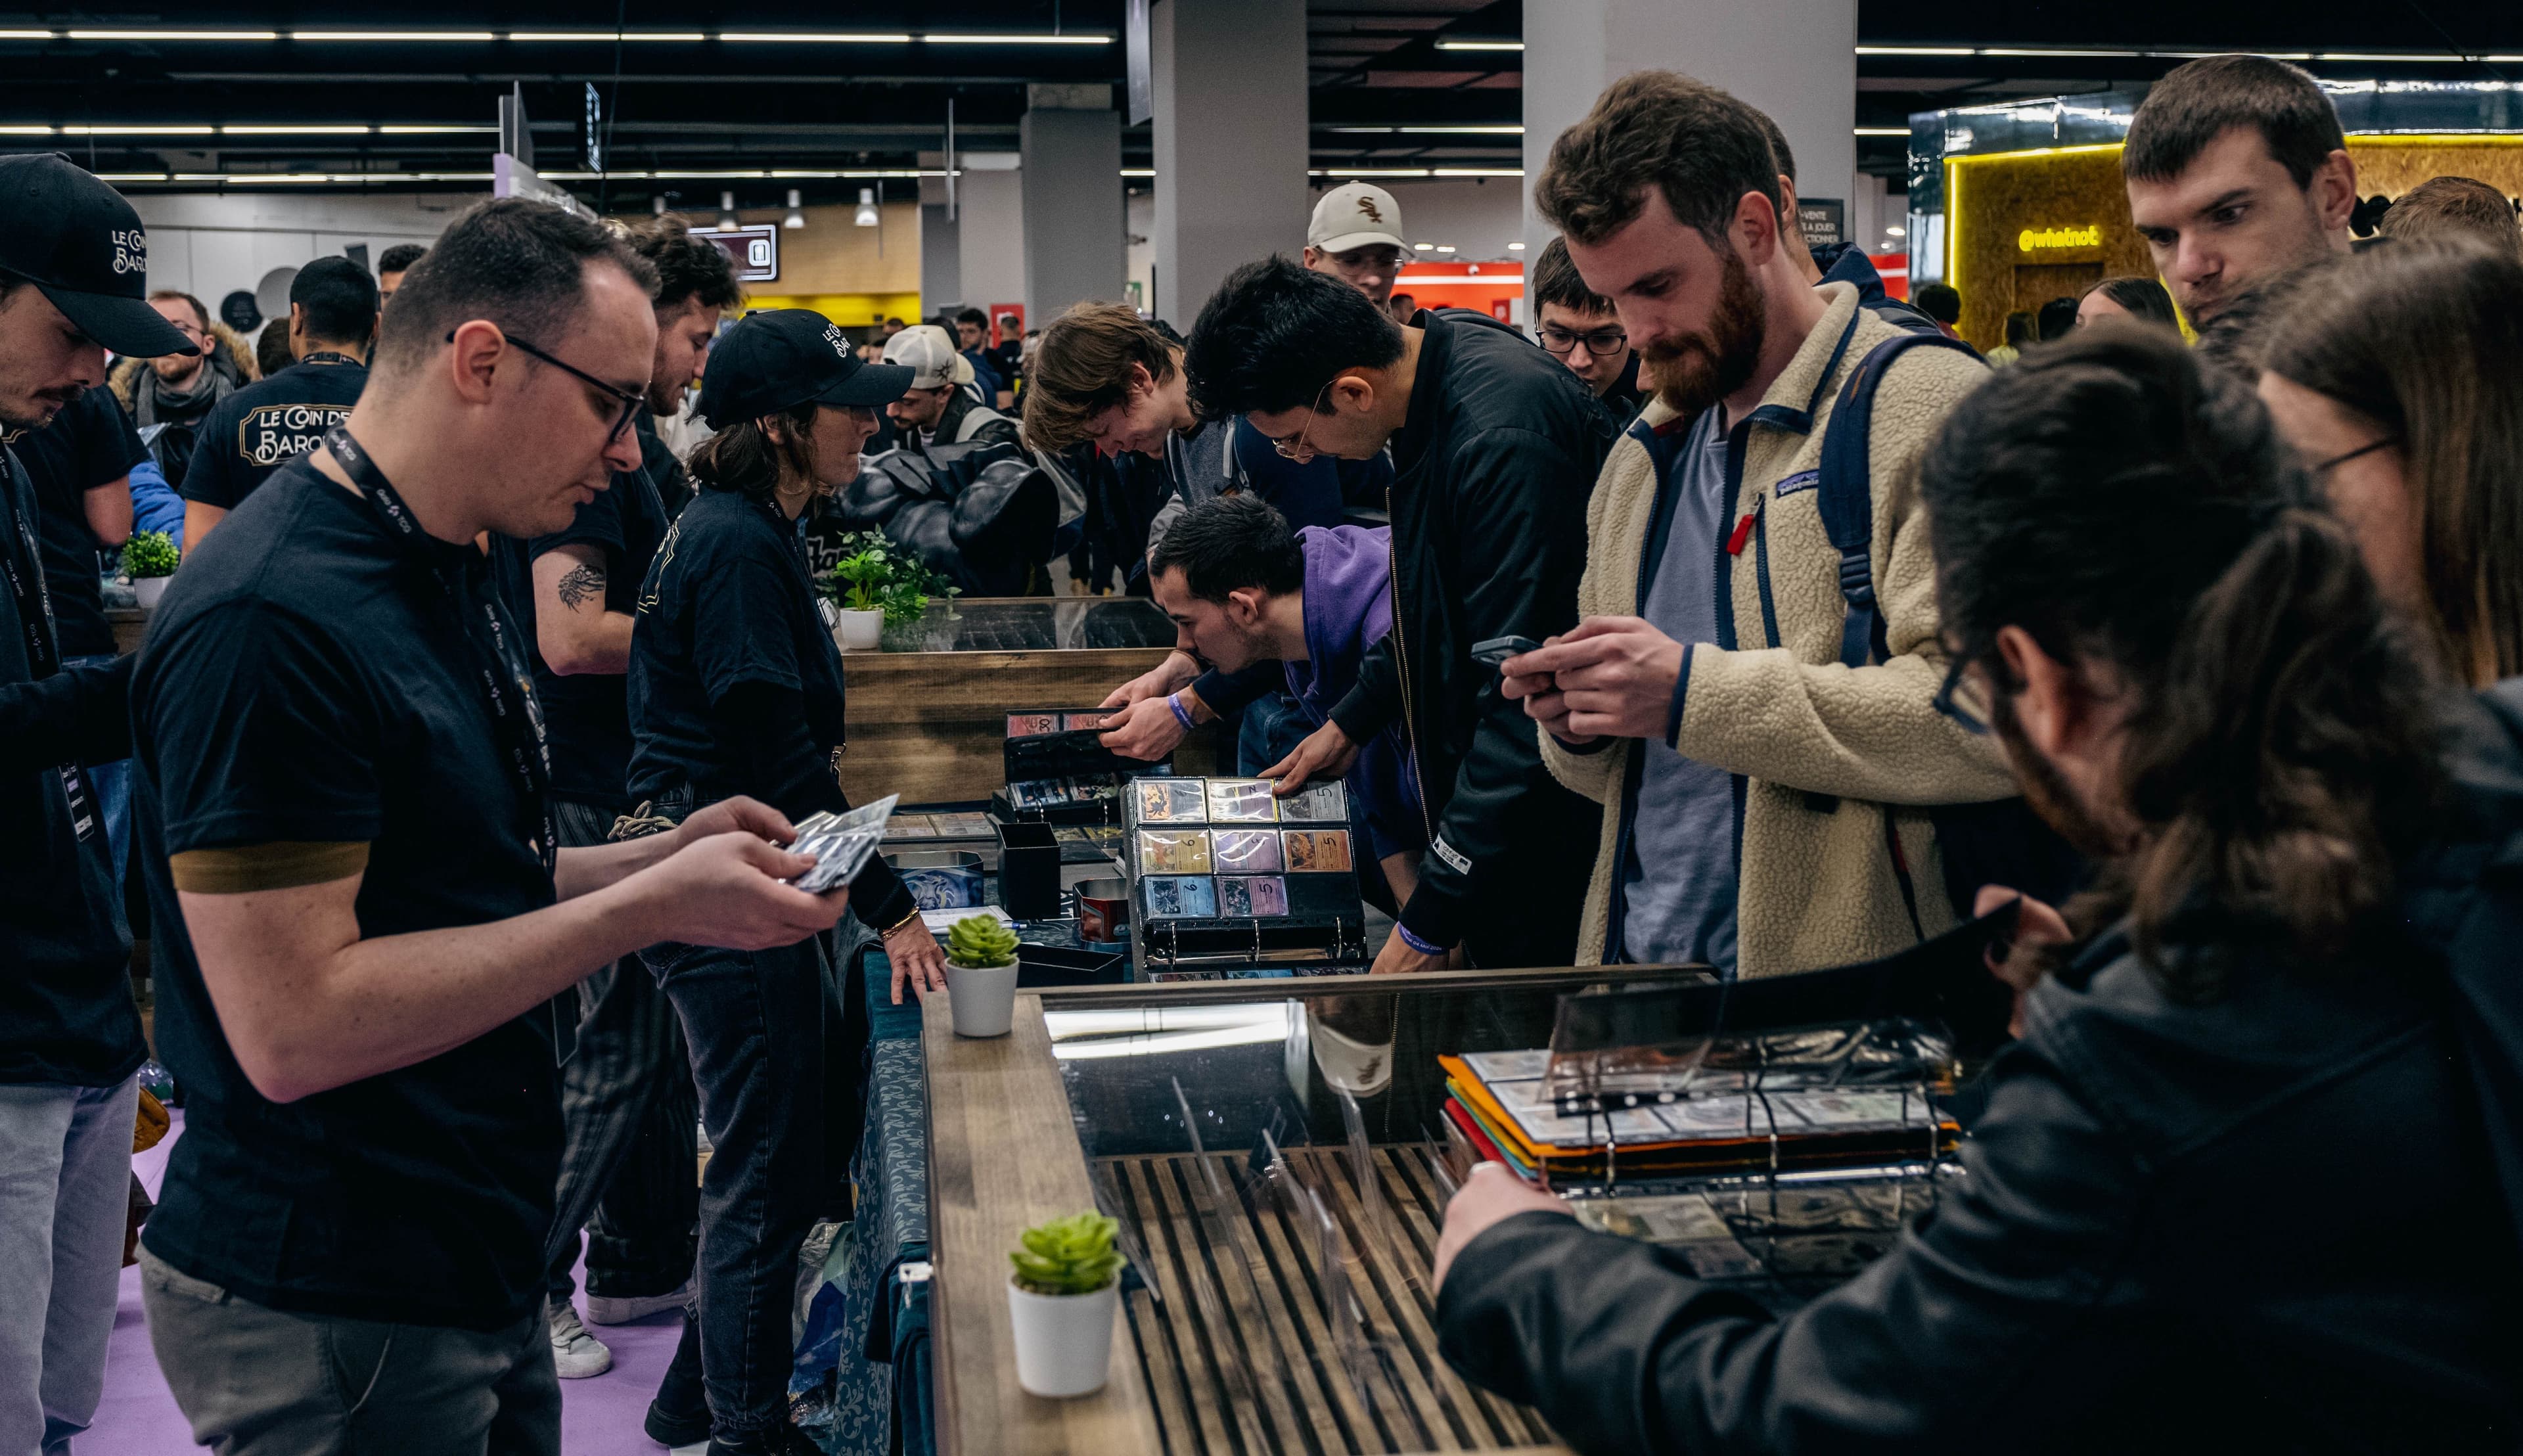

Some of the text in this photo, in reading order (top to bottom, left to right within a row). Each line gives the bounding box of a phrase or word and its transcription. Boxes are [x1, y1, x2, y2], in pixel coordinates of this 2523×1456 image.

[112, 230, 127, 246] LE
[2018, 225, 2099, 252] @whatnot
[822, 330, 835, 342] LE
[260, 411, 281, 428] LE
[284, 405, 323, 430] COIN
[255, 430, 327, 464] BARO
[1317, 788, 1332, 797] 5
[1323, 836, 1336, 846] 5
[1260, 883, 1273, 894] 5
